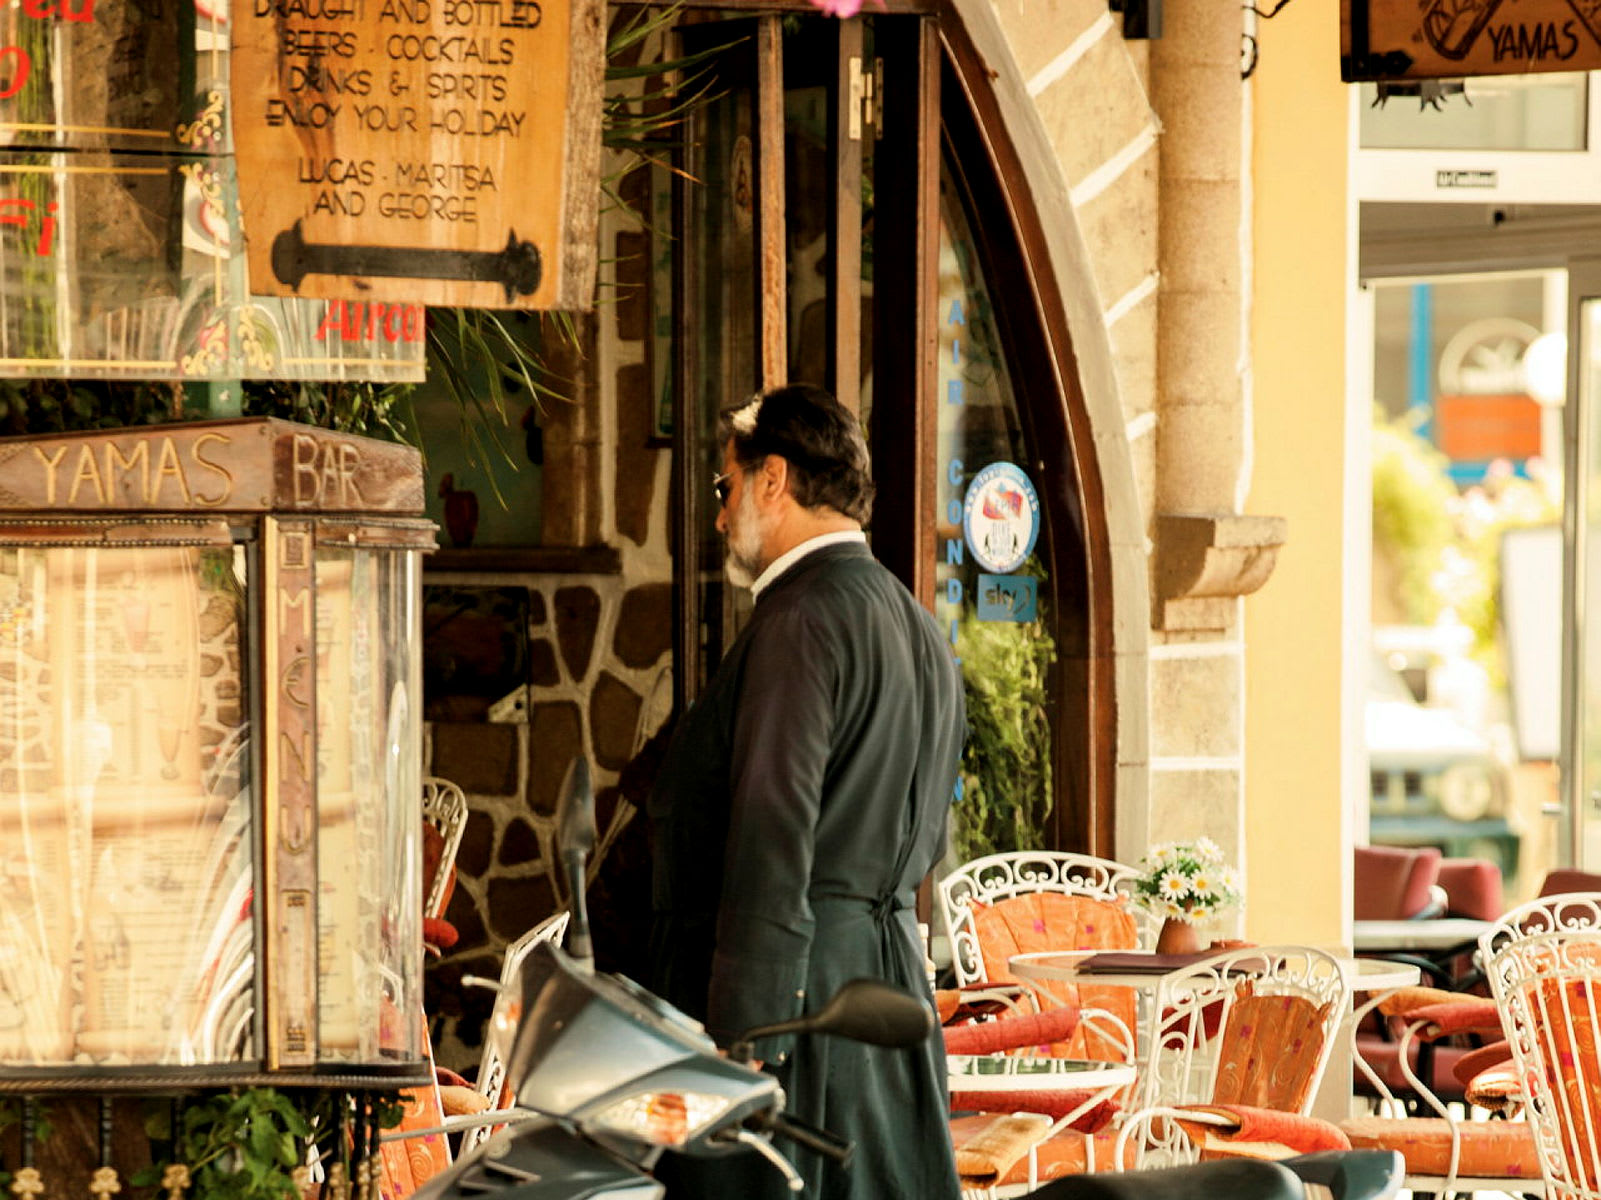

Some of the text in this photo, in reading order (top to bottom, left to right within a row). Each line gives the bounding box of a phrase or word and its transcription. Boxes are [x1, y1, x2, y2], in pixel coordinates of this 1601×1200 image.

[380, 0, 431, 24] AND
[443, 1, 543, 28] BOTTLED
[283, 29, 515, 65] BEERS COCKTAILS
[1486, 19, 1579, 63] YAMAS
[288, 65, 373, 96] DRINKS
[427, 73, 508, 102] SPIRITS
[264, 99, 527, 138] ENJOY YOUR HOLIDAY
[298, 157, 498, 192] LUCAS MARITSA
[313, 189, 478, 223] AND GEORGE
[947, 299, 966, 406] AIR
[33, 432, 366, 507] YAMAS BAR
